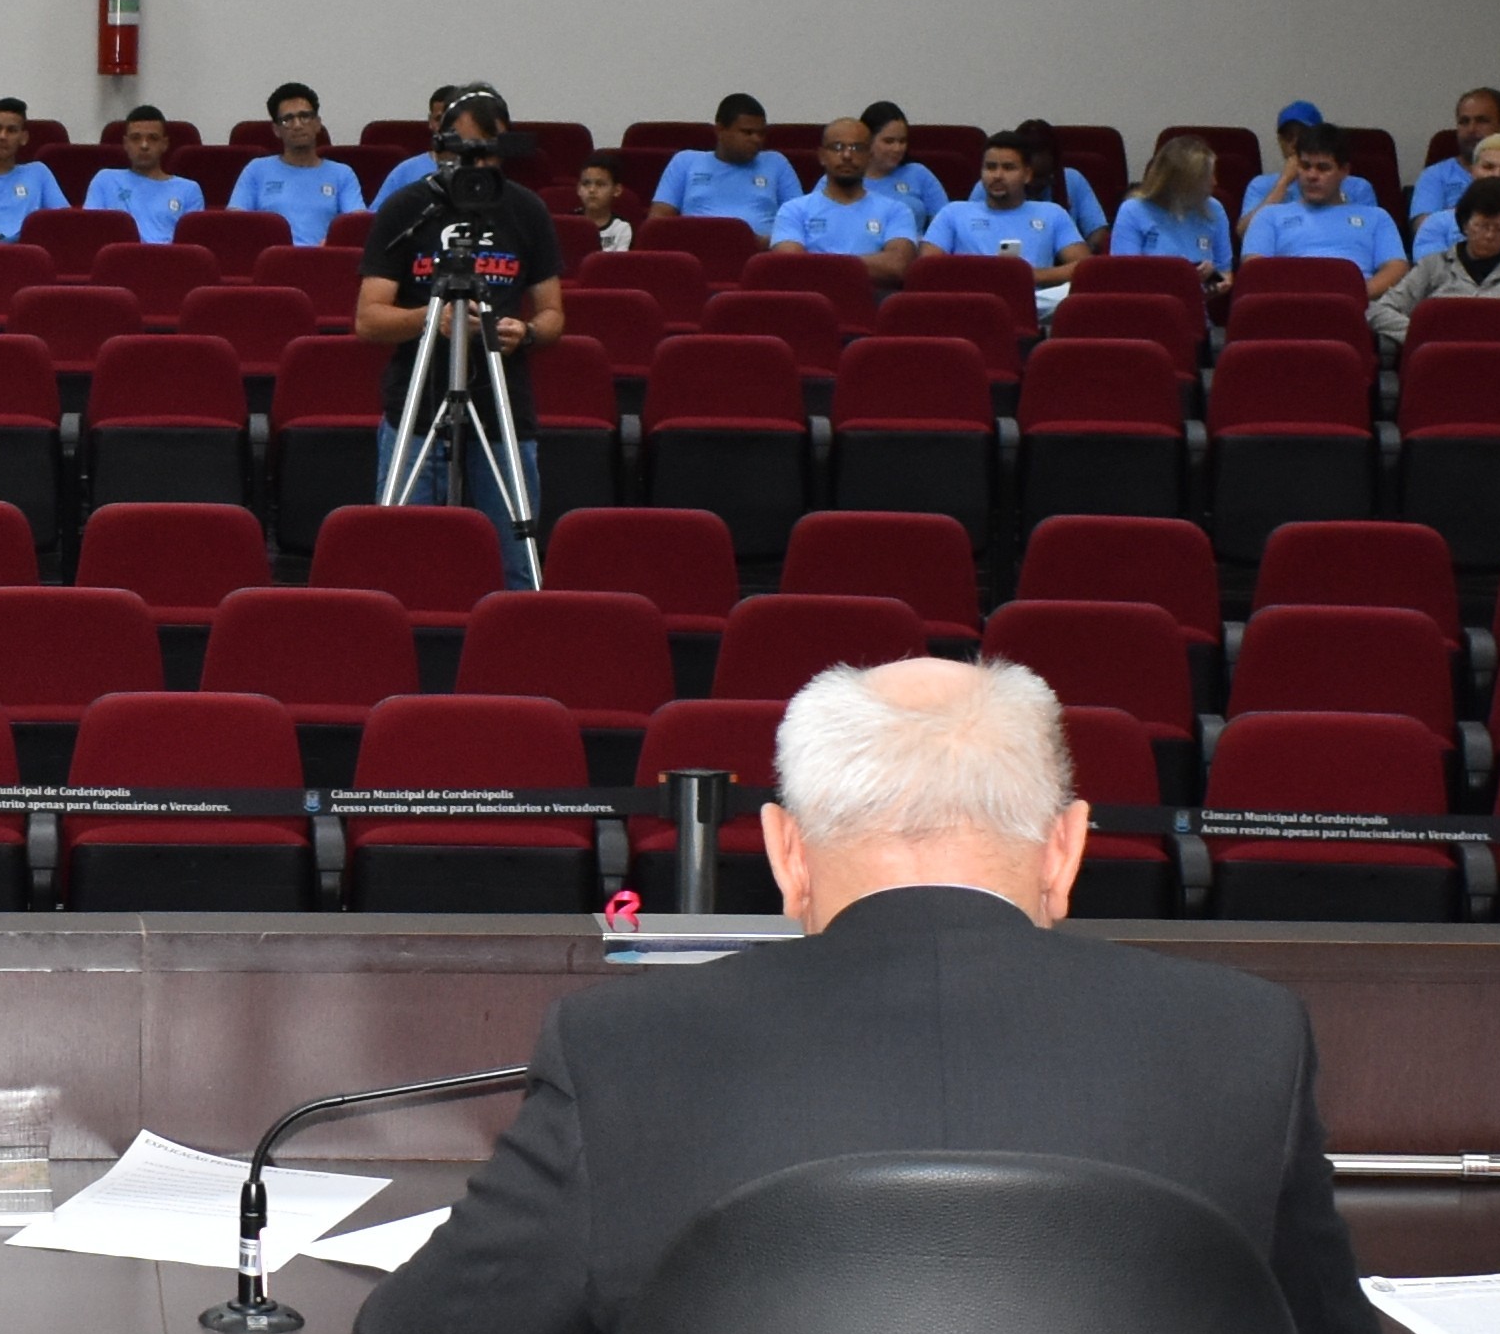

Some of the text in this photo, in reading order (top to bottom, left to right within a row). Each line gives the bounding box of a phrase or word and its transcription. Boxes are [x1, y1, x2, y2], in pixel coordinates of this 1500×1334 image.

[43, 786, 57, 796] de
[59, 786, 131, 799] Cordeirópolis
[331, 789, 514, 801] Câmara Municipal de Cordeirópolis
[27, 801, 65, 810] apenas
[66, 802, 91, 811] para
[92, 801, 159, 811] funcionários
[169, 802, 231, 812] Vereadores.
[331, 803, 367, 813] Acesso
[368, 803, 409, 813] restrito
[410, 805, 448, 815] apenas
[449, 805, 474, 815] para
[475, 803, 543, 813] funcionários
[552, 803, 615, 813] Vereadores.
[1244, 811, 1298, 825] Municipal
[1299, 813, 1313, 823] de
[1201, 824, 1238, 835] Acesso
[1239, 826, 1281, 836] restrito
[1281, 828, 1320, 839] apenas
[1322, 829, 1348, 839] para
